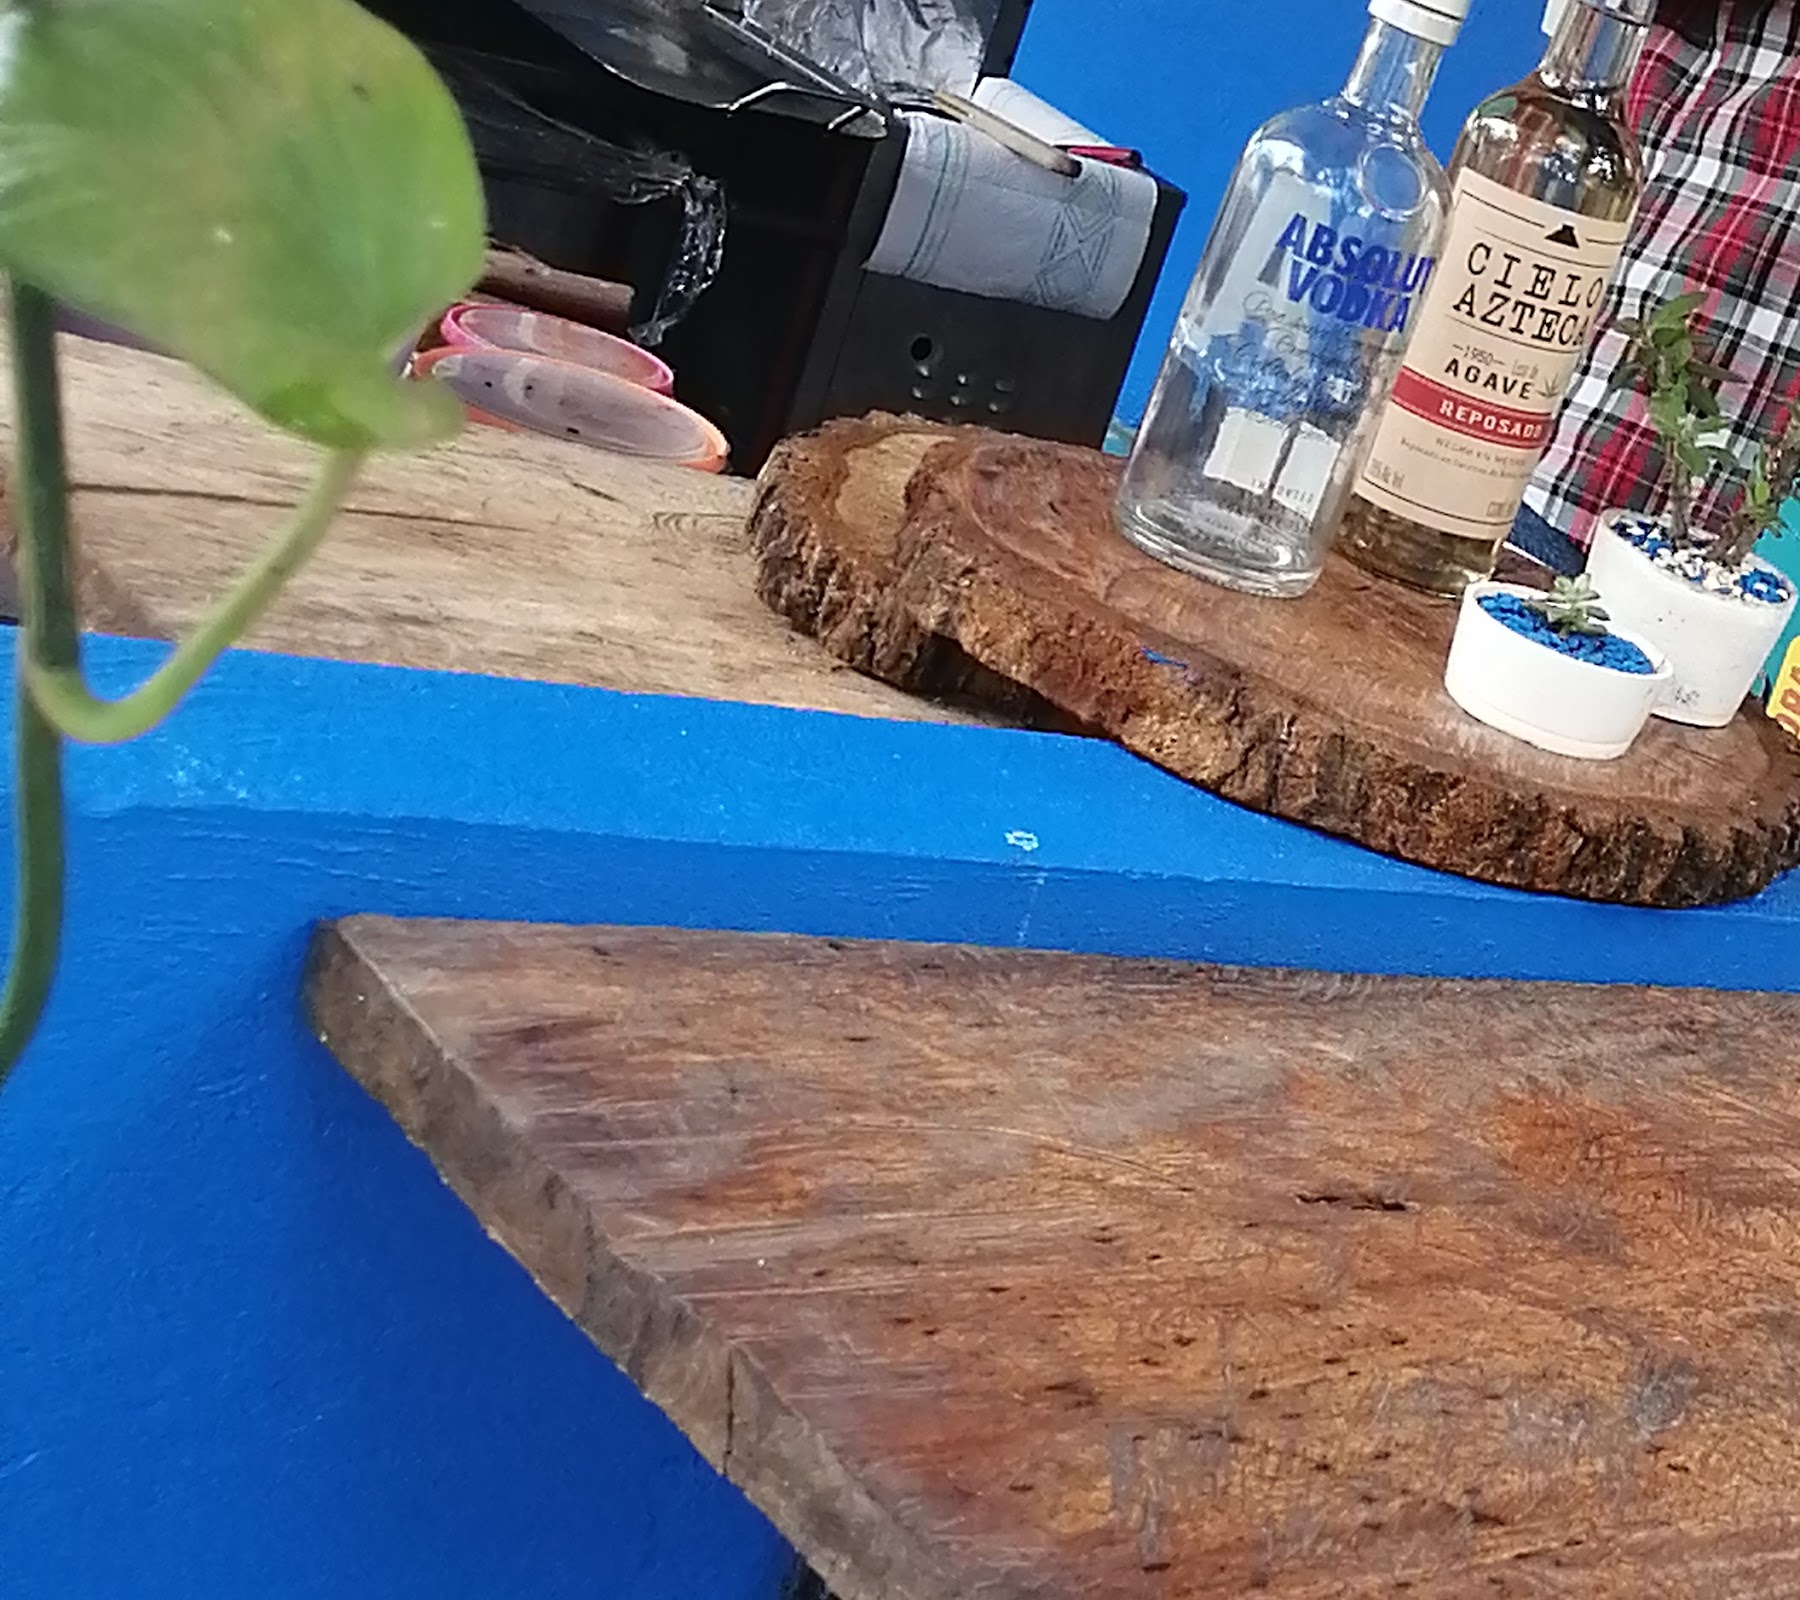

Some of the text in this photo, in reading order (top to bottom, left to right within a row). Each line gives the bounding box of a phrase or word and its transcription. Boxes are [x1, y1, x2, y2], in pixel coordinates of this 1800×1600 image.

[1286, 259, 1412, 333] VODKA
[1467, 242, 1604, 308] CIELO
[1444, 358, 1535, 400] AGAVE
[1439, 399, 1543, 439] REPOSADO
